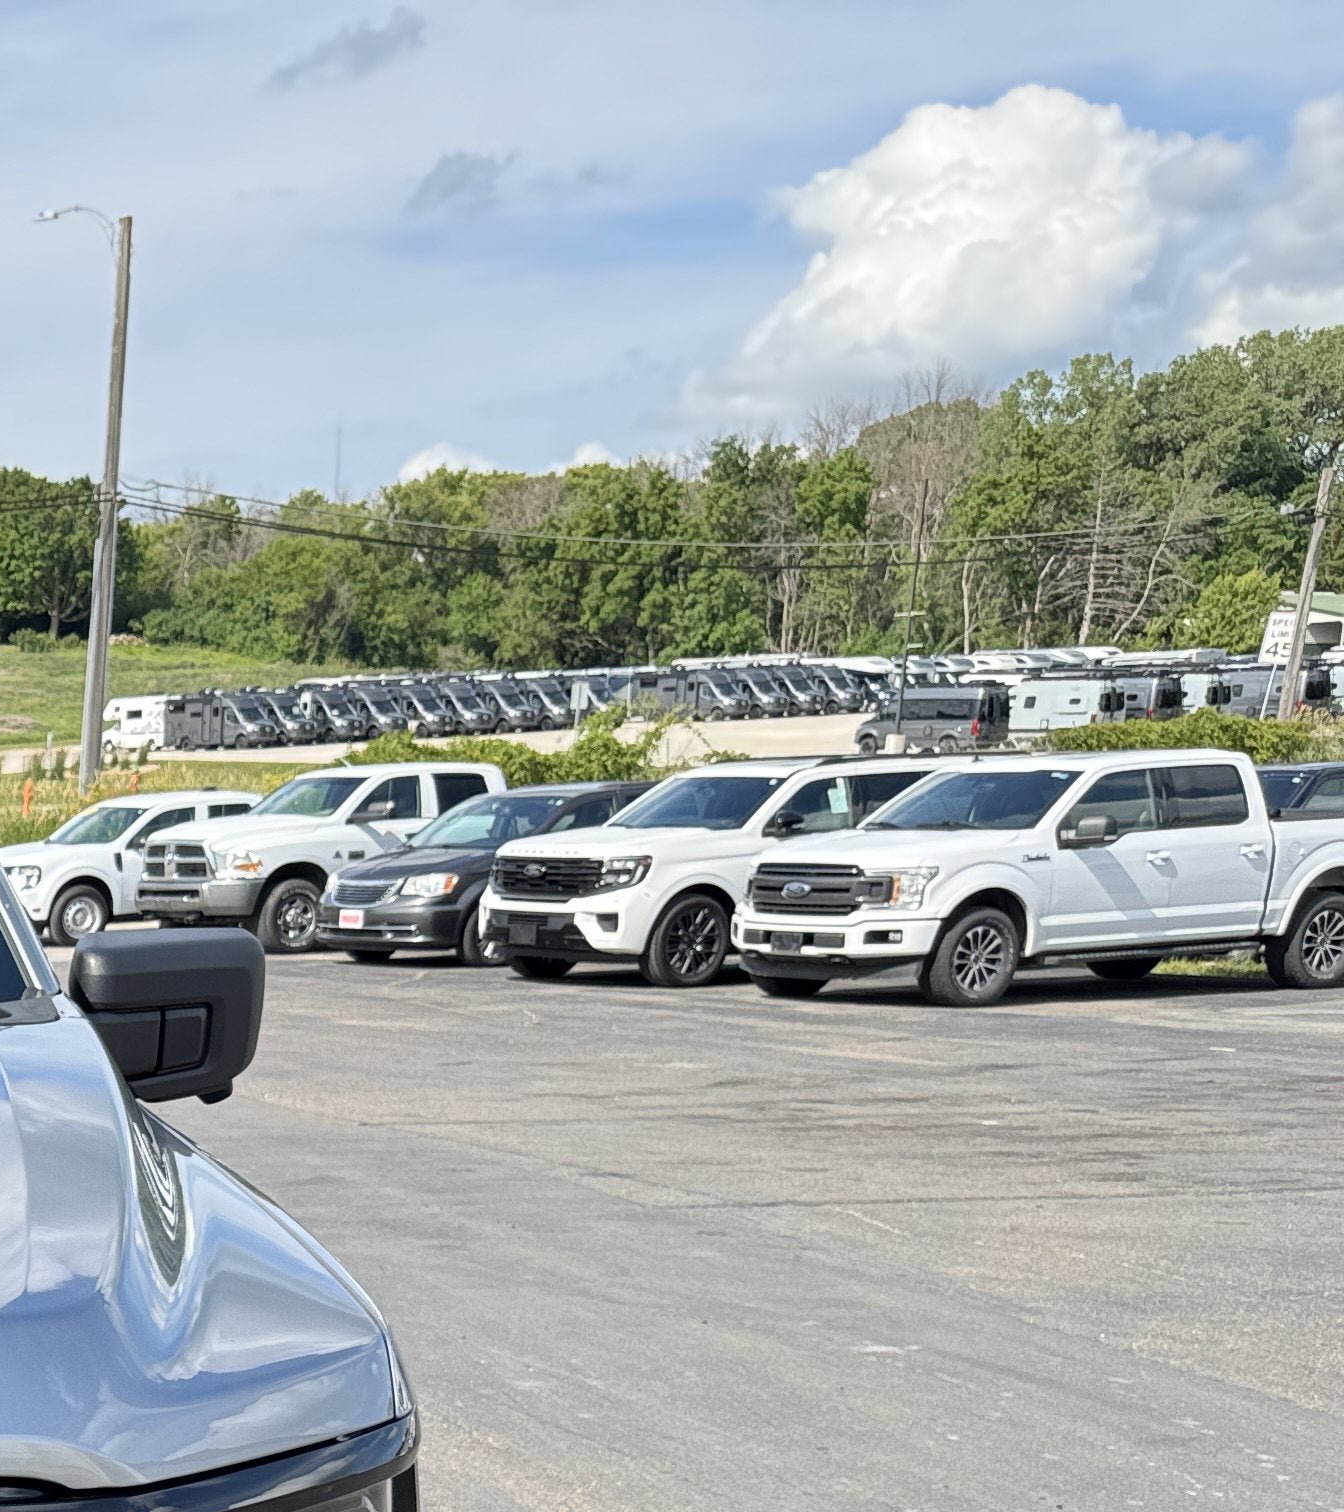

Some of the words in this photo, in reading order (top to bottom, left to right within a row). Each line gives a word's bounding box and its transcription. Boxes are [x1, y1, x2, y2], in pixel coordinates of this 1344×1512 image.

[1271, 618, 1294, 626] SPE
[1271, 630, 1290, 638] LIMI
[1264, 641, 1292, 658] 45
